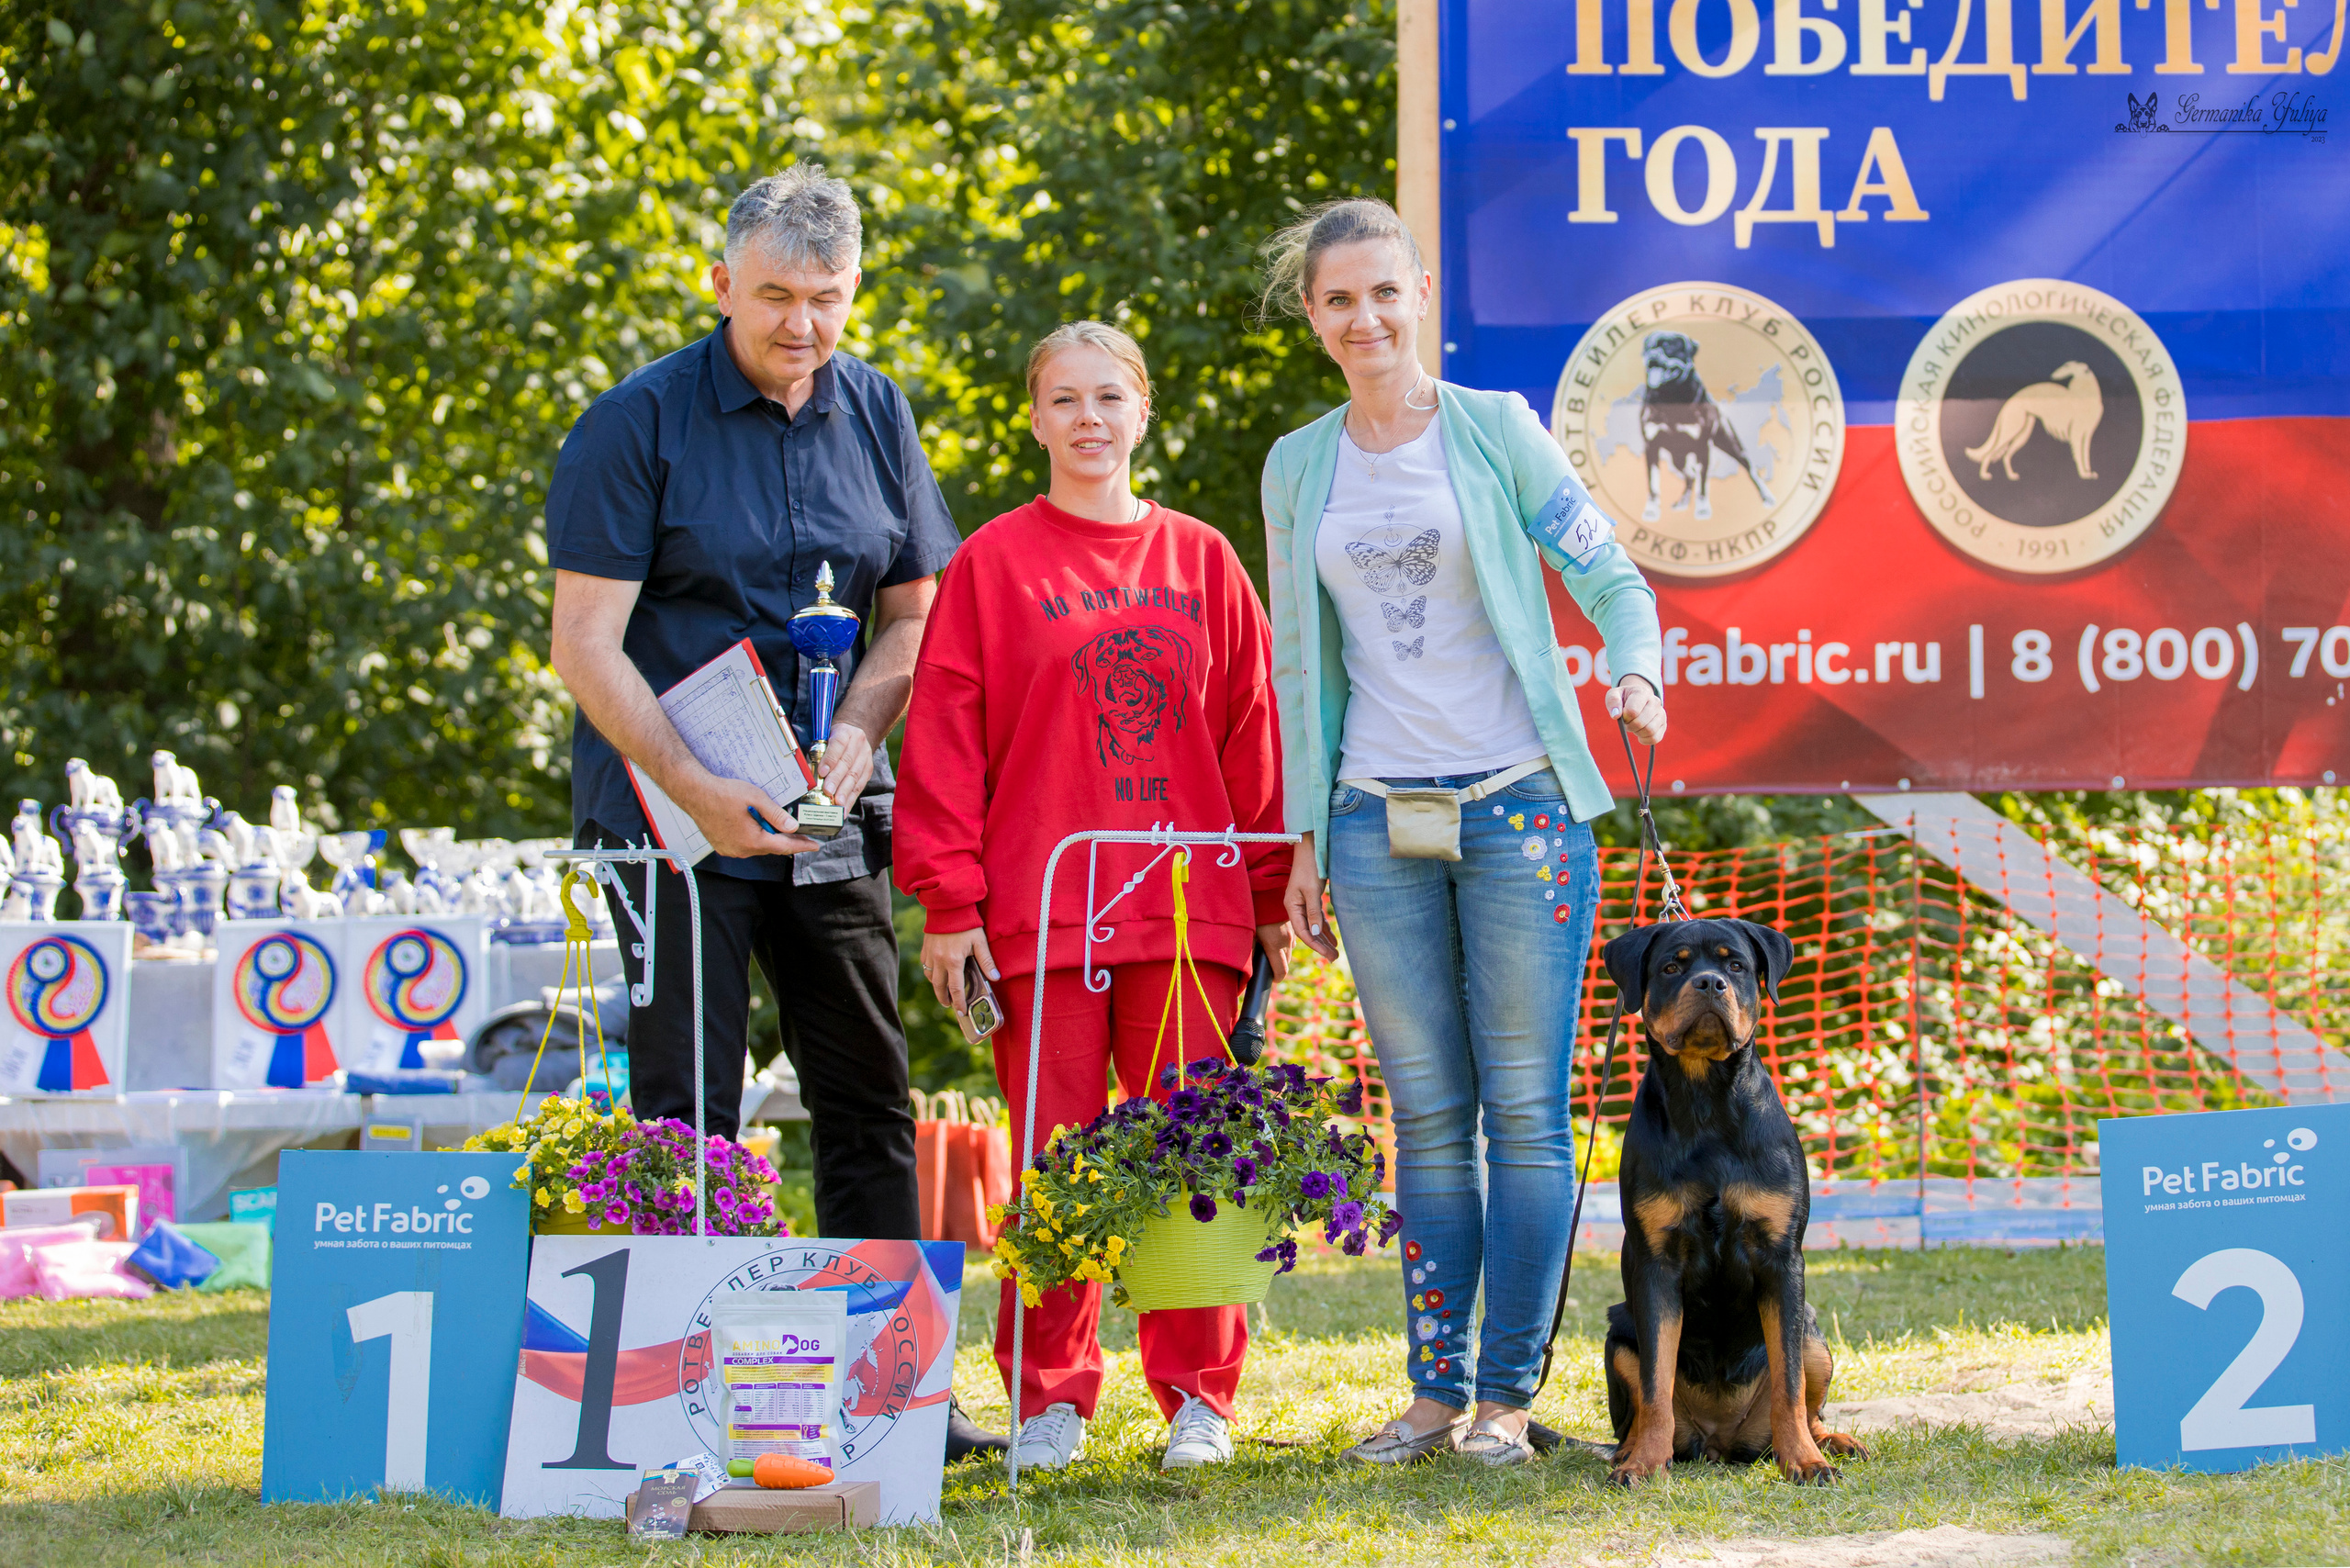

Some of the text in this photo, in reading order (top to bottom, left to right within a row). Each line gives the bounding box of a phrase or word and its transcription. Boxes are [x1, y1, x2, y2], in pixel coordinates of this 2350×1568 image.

[1566, 125, 1930, 250] ГОДА
[1690, 295, 1783, 337] КЛУБ
[1789, 343, 1833, 492] РОССИИ
[1909, 290, 2175, 539] РОССИЙСКАЯ КИНОЛОГИЧЕСКАЯ ФЕДЕРАЦИЯ
[1575, 519, 1598, 551] 52
[1630, 520, 1778, 562] РКФ-НКПР
[2017, 538, 2071, 559] 1991
[1039, 587, 1203, 628] NO ROTTWEILER,
[1558, 626, 1942, 687] pfabric.ru
[2010, 629, 2053, 683] 8
[2077, 622, 2260, 693] (800)
[1114, 777, 1169, 801] NO LIFE
[2144, 1193, 2306, 1214] умная забота о ваших питомцах
[314, 1238, 472, 1250] умная забота о ваших питомцах
[541, 1248, 637, 1471] 1
[683, 1251, 914, 1422] РОТВЕЛЕР КЛУБ РОССИИ
[732, 1357, 774, 1365] COMPLEX
[2171, 1248, 2317, 1451] 2
[346, 1291, 434, 1493] 1
